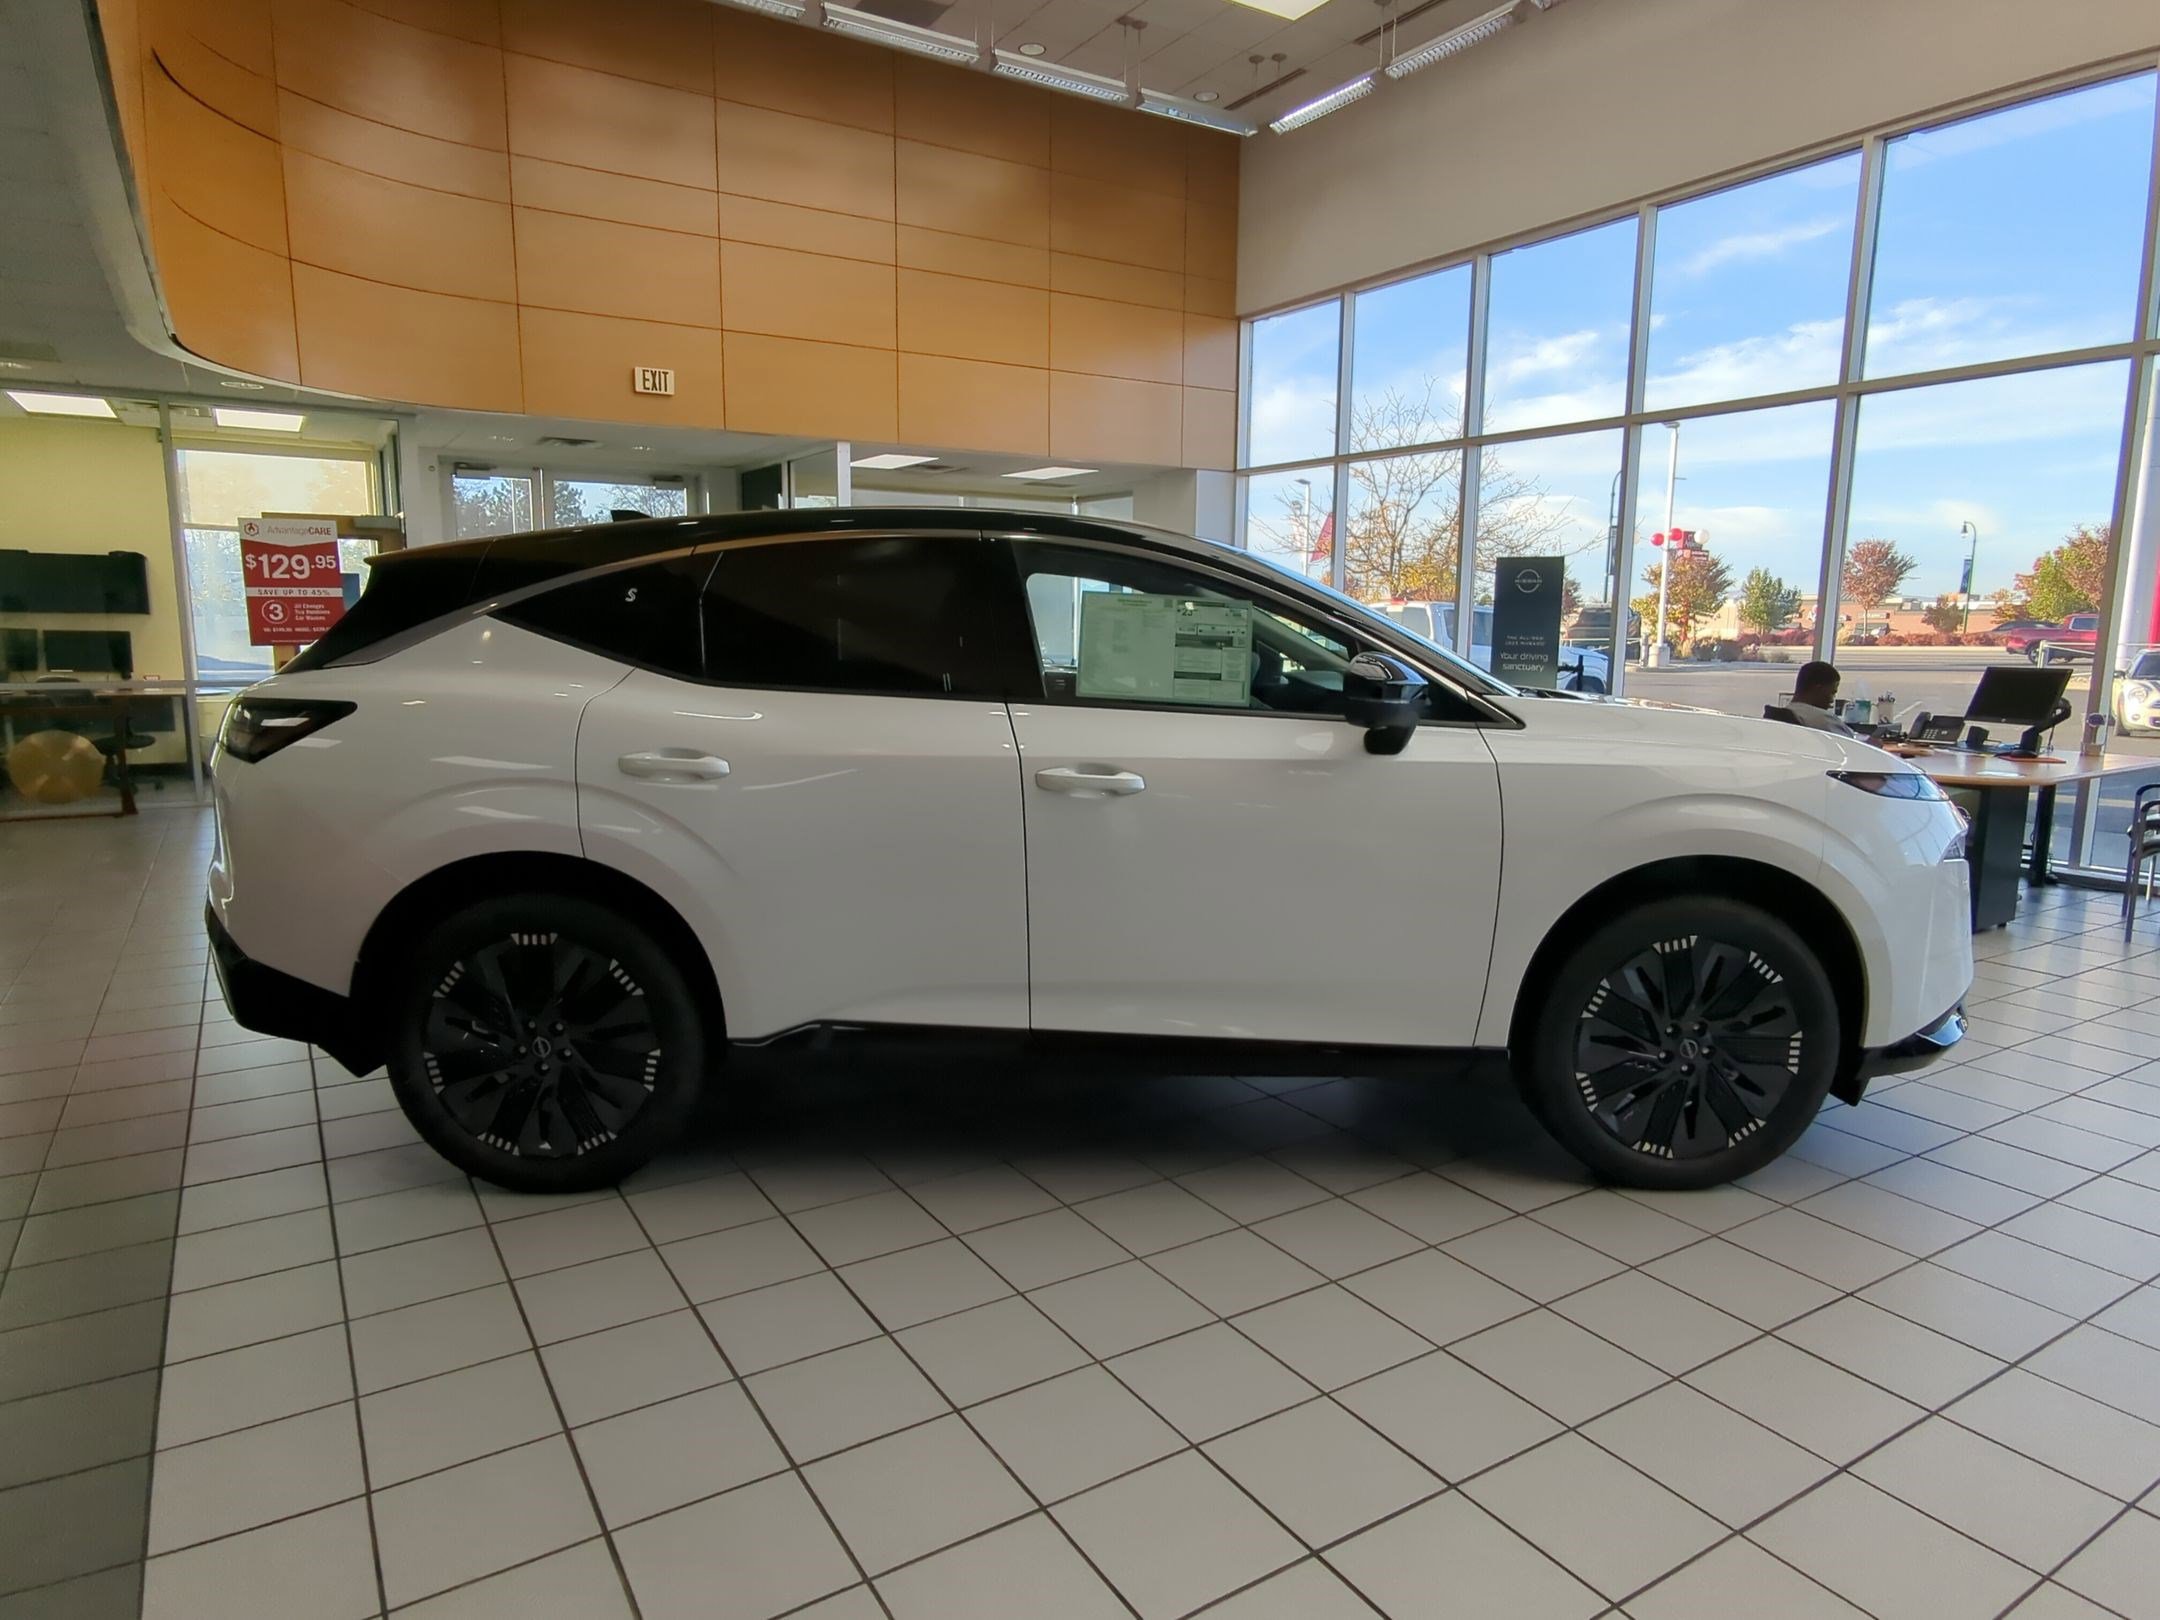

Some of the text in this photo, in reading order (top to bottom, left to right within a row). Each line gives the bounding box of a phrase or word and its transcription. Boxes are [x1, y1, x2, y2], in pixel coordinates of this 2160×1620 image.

[642, 369, 669, 392] EXIT
[245, 553, 337, 579] $129.95
[257, 588, 278, 596] SAVE
[268, 603, 284, 621] 3
[1500, 652, 1549, 663] Your driving
[1502, 664, 1544, 673] sanctuary
